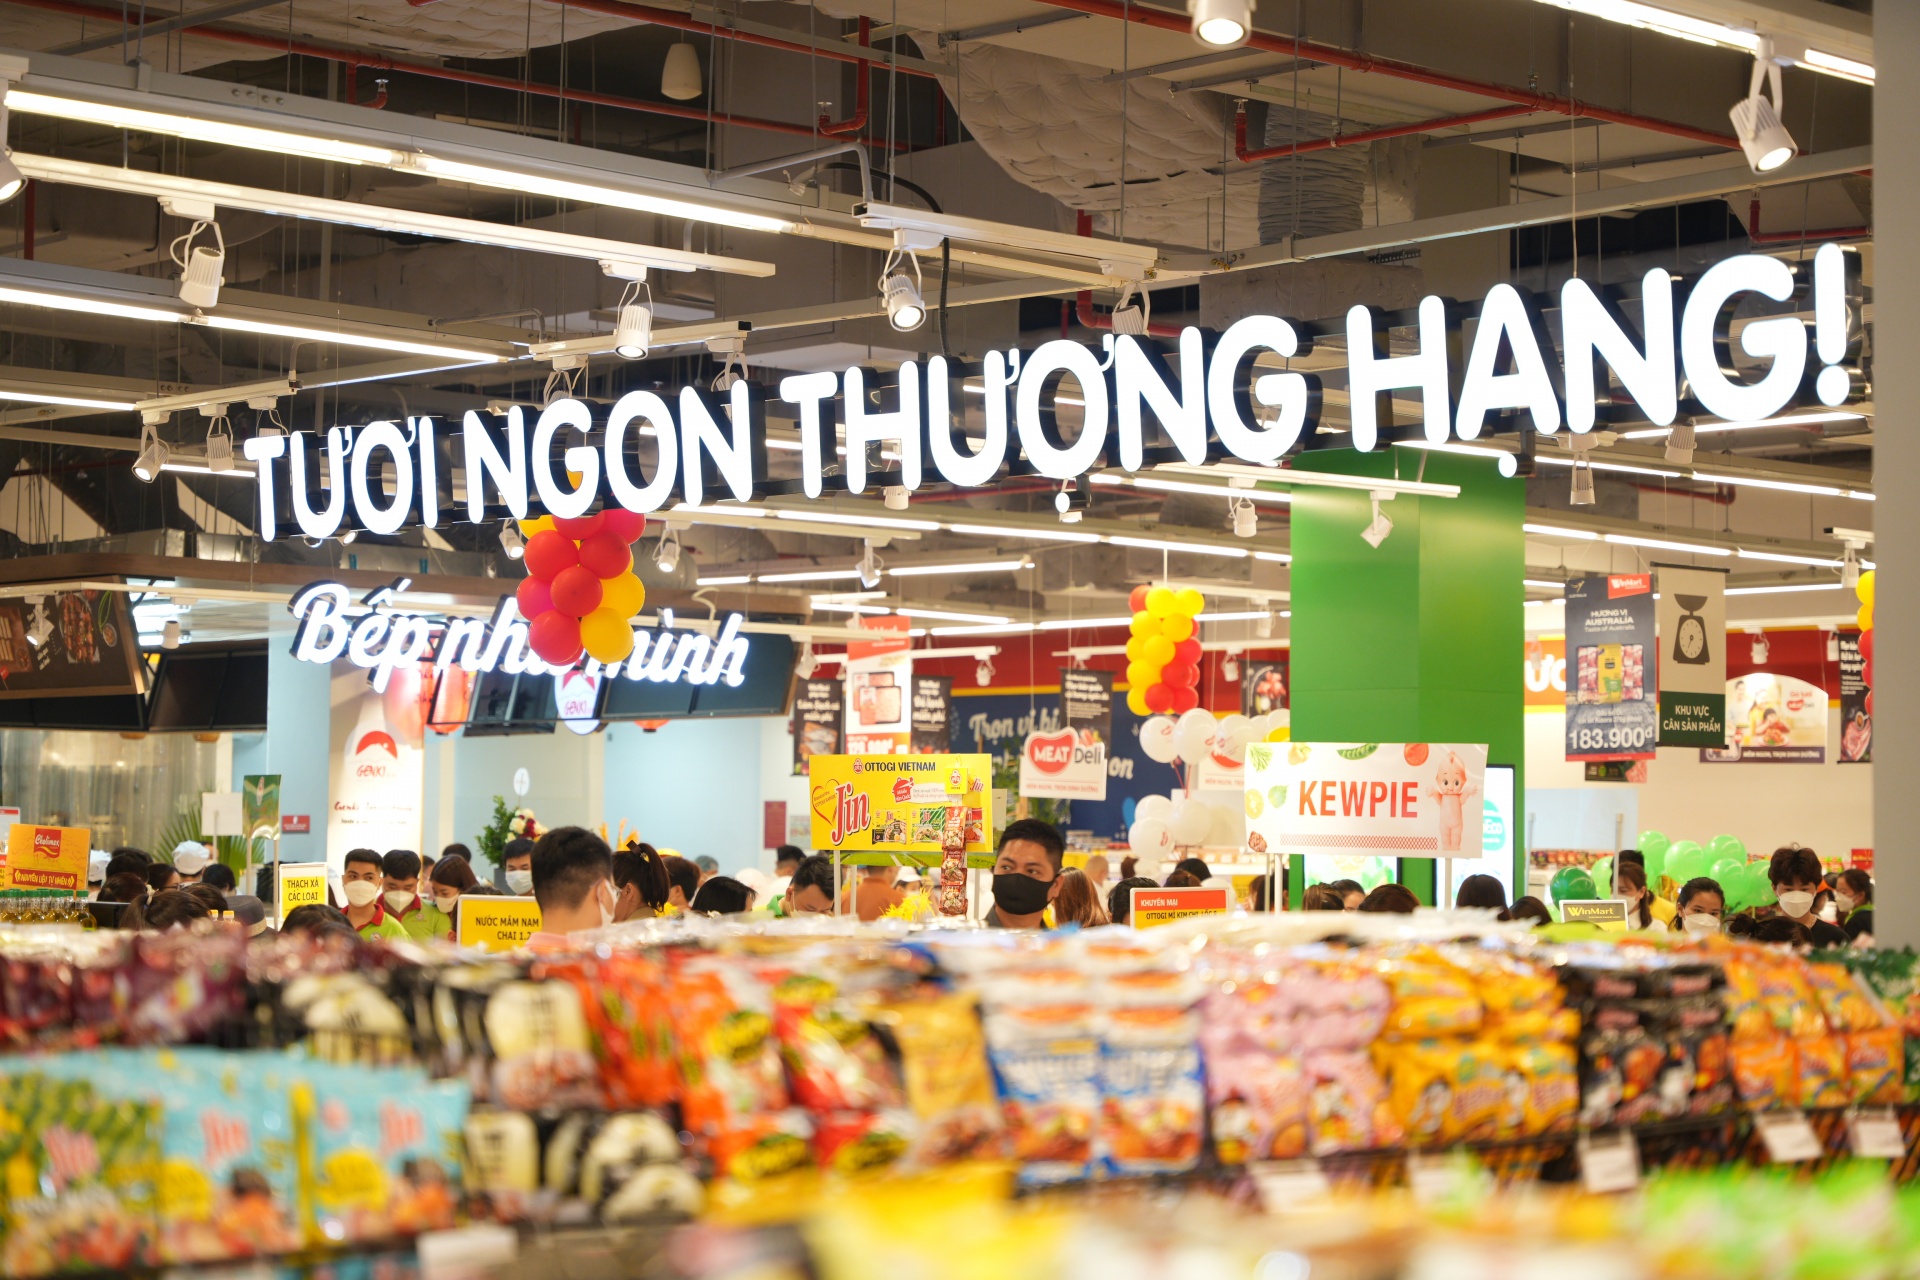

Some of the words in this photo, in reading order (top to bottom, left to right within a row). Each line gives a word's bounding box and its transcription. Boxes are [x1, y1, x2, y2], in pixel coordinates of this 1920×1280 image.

[244, 415, 439, 542] TƯƠI
[462, 380, 752, 525] NGON
[779, 314, 1309, 515] THƯỢNG
[1345, 242, 1853, 479] HẠNG!
[290, 577, 433, 694] Bếp
[436, 594, 582, 677] nh
[1674, 705, 1692, 715] KHU
[1692, 705, 1710, 718] VỰC
[1663, 718, 1681, 731] CÂN
[1681, 718, 1697, 732] SẢN
[1698, 716, 1721, 733] PHẨM
[1033, 745, 1072, 764] MEAT
[1074, 746, 1102, 765] Deli
[356, 764, 386, 778] GENKI
[864, 761, 896, 772] OTTOGI
[899, 761, 936, 772] VIETNAM
[1298, 780, 1419, 819] KEWPIE
[831, 782, 872, 846] Jin
[287, 879, 309, 891] THẠCH
[288, 889, 301, 902] CÁC
[302, 891, 319, 903] LOẠI
[1140, 897, 1165, 907] KHUYẾN
[1146, 912, 1167, 920] OTTOGI
[1567, 906, 1614, 917] WinMart
[475, 915, 498, 927] NƯỚC
[521, 918, 539, 927] NAM
[497, 931, 517, 941] CHAI
